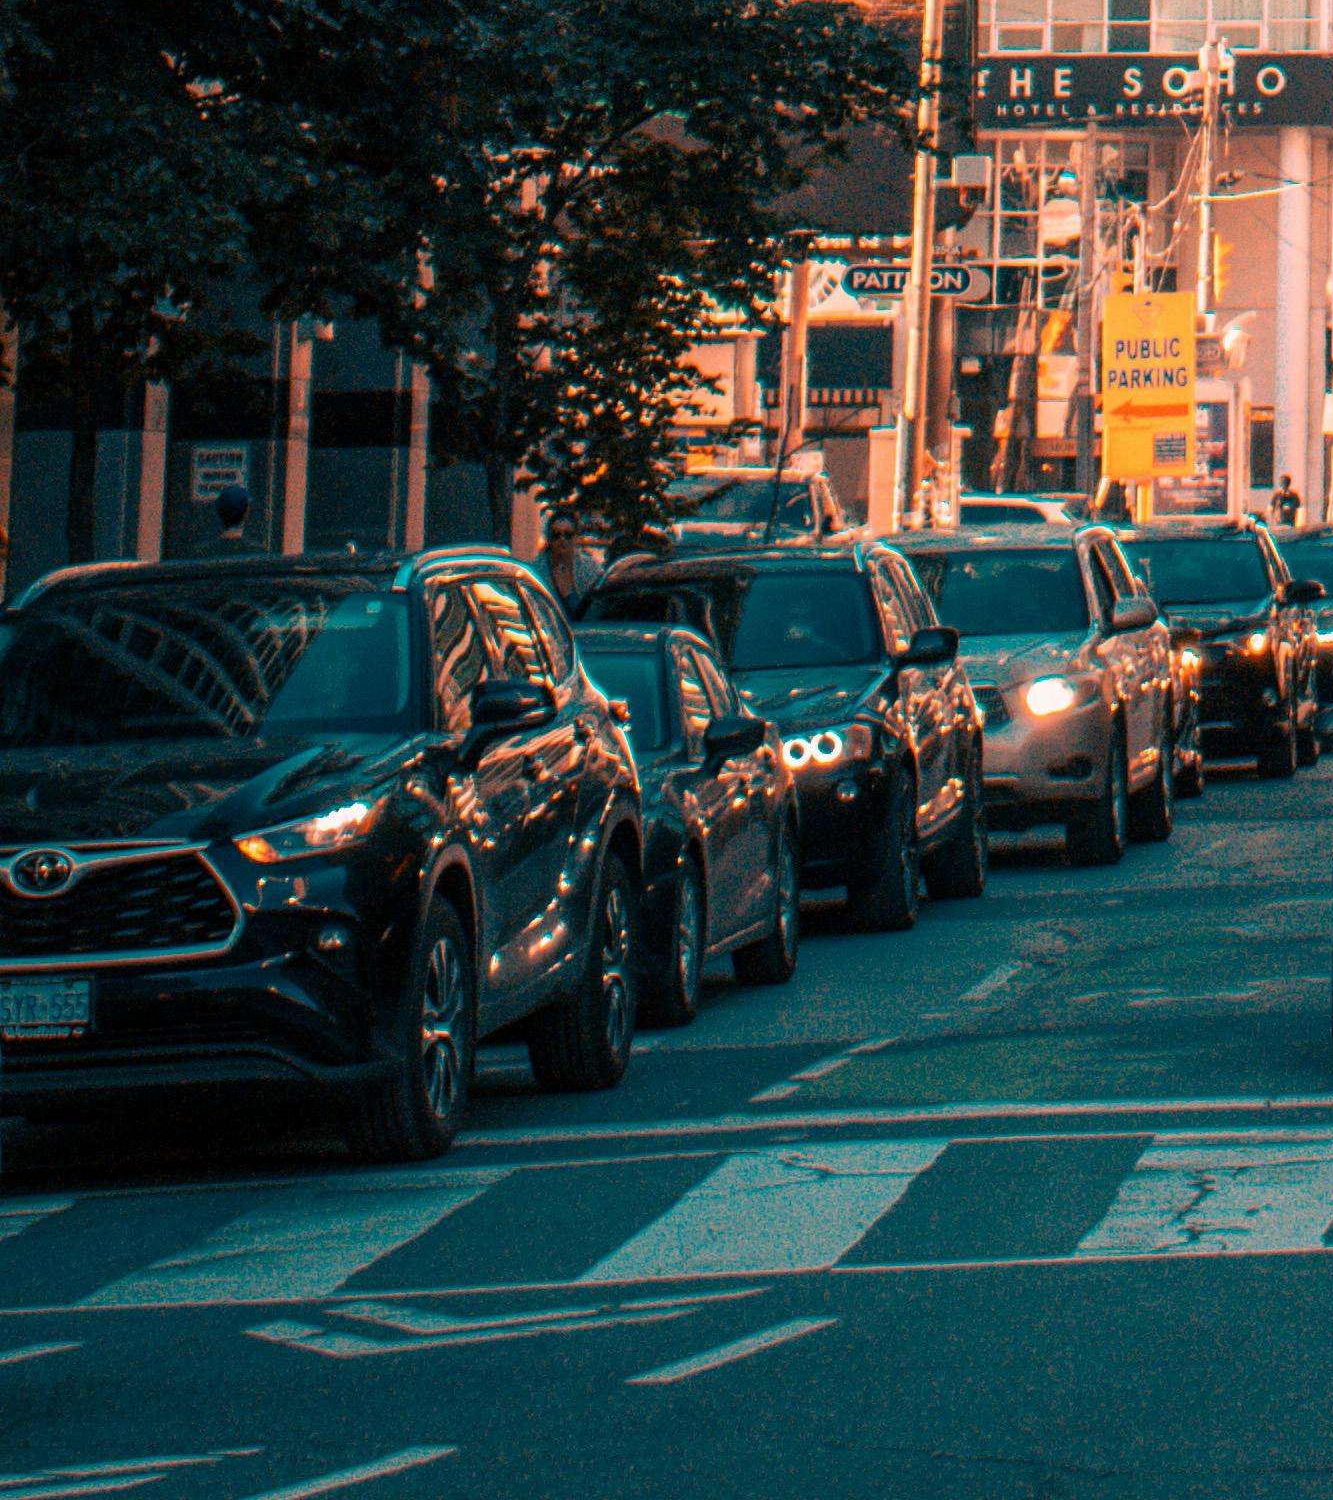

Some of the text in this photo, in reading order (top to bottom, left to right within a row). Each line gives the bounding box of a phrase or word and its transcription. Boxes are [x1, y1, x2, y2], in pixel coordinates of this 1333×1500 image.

[996, 104, 1071, 118] HOTEL
[1116, 103, 1264, 117] RESIDECES
[1115, 337, 1181, 360] PUBLIC
[1108, 367, 1188, 389] PARKING
